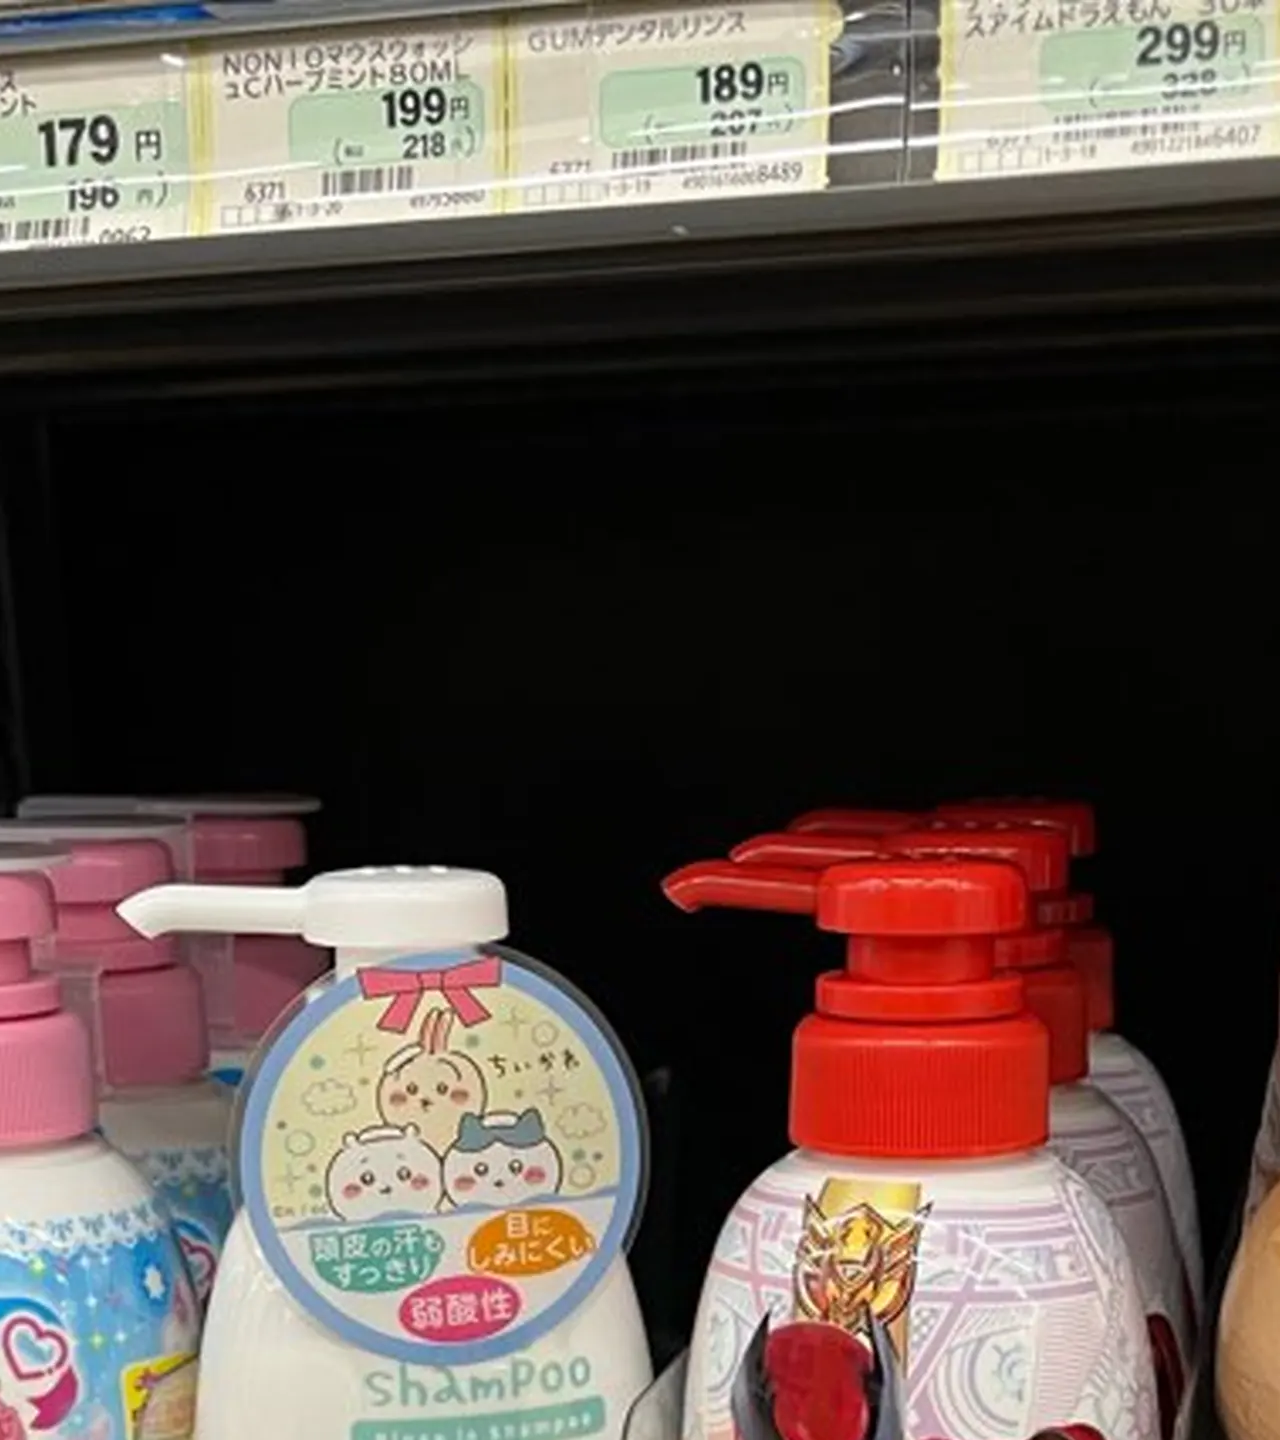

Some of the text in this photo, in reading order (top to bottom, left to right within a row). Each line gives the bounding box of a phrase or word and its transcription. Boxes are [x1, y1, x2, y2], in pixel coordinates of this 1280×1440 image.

[528, 11, 748, 52] GUMデンタルリンス
[507, 1212, 551, 1236] 目に
[311, 1228, 444, 1263] 頭皮の汗も
[469, 1235, 594, 1271] しみにくい
[334, 1254, 431, 1284] すっきり
[409, 1288, 513, 1330] 弱酸性
